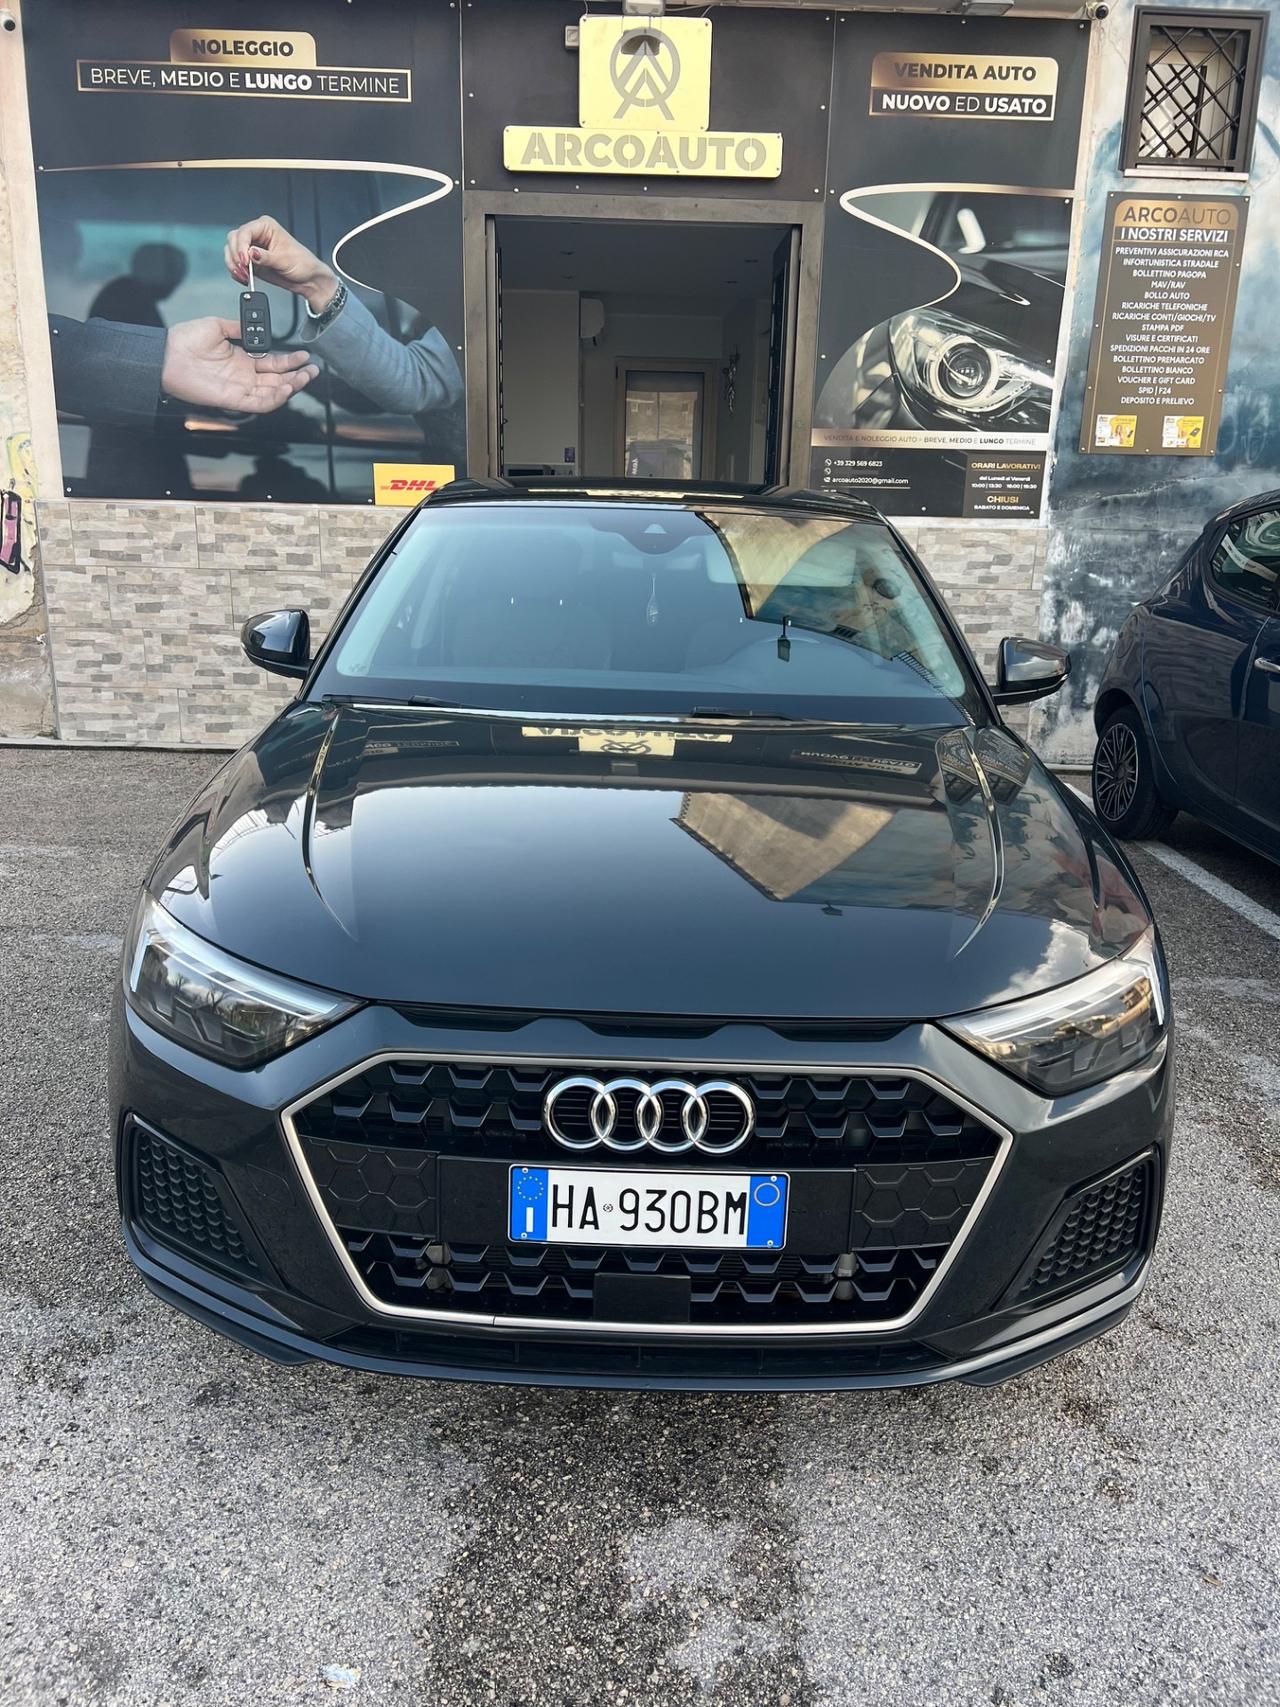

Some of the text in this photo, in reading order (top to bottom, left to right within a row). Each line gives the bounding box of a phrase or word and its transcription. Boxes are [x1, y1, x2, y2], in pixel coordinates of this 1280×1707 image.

[191, 39, 294, 57] NOLEGGIO
[894, 62, 1037, 81] VENDITA AUTO
[91, 68, 400, 94] BREVE, MEDIO E LUNGO TERMINE
[882, 94, 1047, 114] NUOVO ED USATO
[520, 132, 767, 172] ARCOAUTO
[1123, 206, 1231, 225] ARCOAUTO
[1121, 227, 1229, 242] I NOSTRI SERVIZI
[1115, 246, 1229, 258] PREVENTIVI ASSICURAZIONI RCA
[1123, 258, 1219, 268] INFORTUNISTICA STRADALE
[1132, 269, 1207, 279] BOLLETTINO PAGOPA
[1151, 280, 1186, 289] MAV/RAV
[1144, 291, 1190, 300] BOLLO AUTO
[1121, 302, 1208, 311] RICARICHE TELEFONICHE
[1112, 312, 1216, 322] RICARICHE CONTI/GIOCHI/TV
[1141, 323, 1185, 332] STAMPA PDF
[1125, 334, 1199, 343] VISURE E CERTIFICATI
[1110, 344, 1149, 352] SPEDIZIONI
[1149, 345, 1176, 353] PACCHI
[1195, 346, 1210, 354] ORE
[1113, 355, 1205, 364] BOLLETTINO PREMARCATO
[1121, 366, 1165, 374] BOLLETTINO
[1117, 376, 1152, 384] VOUCHER
[1158, 376, 1175, 384] GIFT
[1174, 377, 1196, 385] CARD
[1158, 387, 1172, 395] F24
[1120, 396, 1195, 405] DEPOSITO E PRELIEVO
[861, 435, 898, 443] NOLEGGIO
[390, 479, 438, 491] DHL
[986, 495, 1019, 503] CHIUSI
[551, 1183, 748, 1236] HA 930BM
